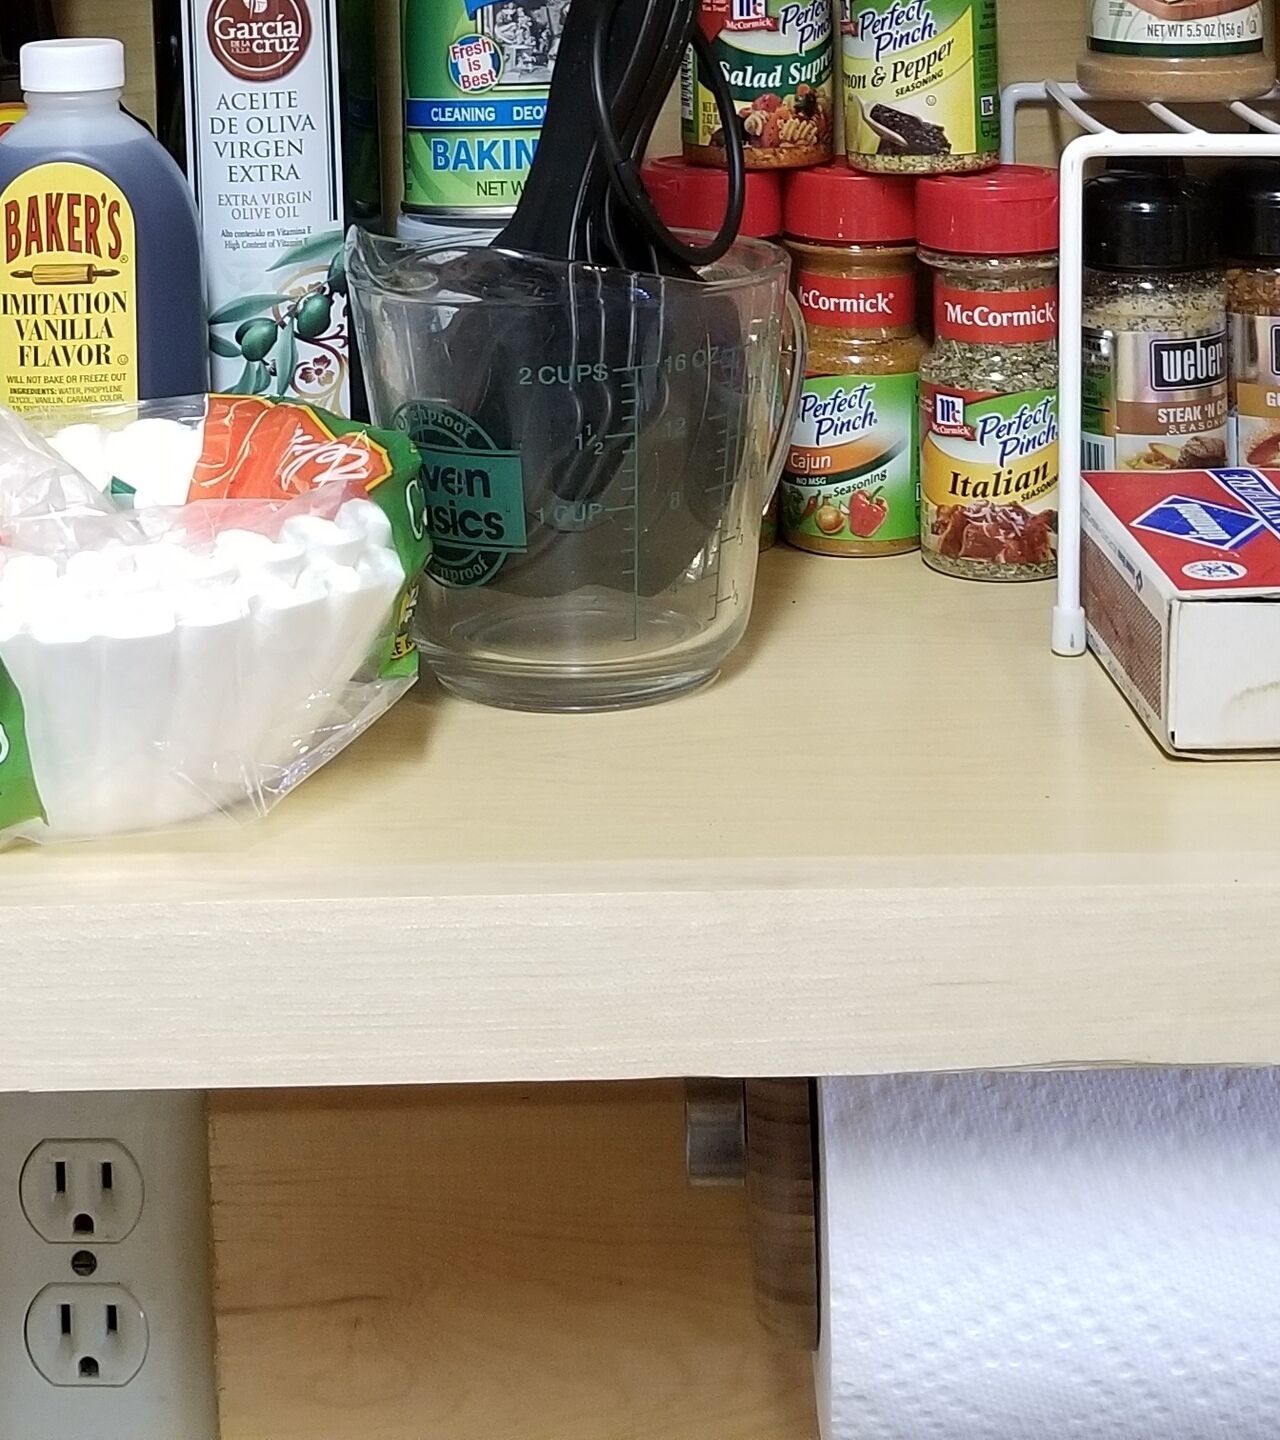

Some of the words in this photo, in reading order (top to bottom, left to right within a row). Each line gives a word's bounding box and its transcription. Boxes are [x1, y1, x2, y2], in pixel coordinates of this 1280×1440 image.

[214, 14, 300, 39] García
[876, 14, 934, 60] Pinch
[1147, 24, 1165, 37] NET
[1168, 25, 1184, 37] WT
[1187, 25, 1201, 37] 5.5
[1204, 24, 1215, 36] OZ
[252, 38, 299, 52] cruz
[451, 39, 492, 60] Fresh
[468, 59, 481, 71] is
[871, 67, 886, 84] &
[892, 38, 954, 84] Pepper
[461, 73, 496, 90] Best
[720, 61, 782, 88] Salad
[895, 69, 943, 97] SEASONING
[216, 91, 297, 110] ACEITE
[210, 117, 238, 134] DE
[246, 114, 316, 134] OLIVA
[431, 107, 496, 122] CLEANING
[213, 139, 303, 158] VIRGEN
[228, 164, 301, 182] EXTRA
[218, 194, 257, 206] EXTRA
[262, 191, 312, 205] VIRGIN
[476, 181, 507, 196] NET
[231, 207, 270, 220] OLIVE
[275, 206, 299, 218] OIL
[5, 193, 122, 264] BAKER'S
[225, 241, 240, 251] High
[242, 240, 267, 249] Content
[2, 291, 127, 315] IMITATION
[945, 301, 1055, 327] McCormick
[15, 318, 114, 341] VANILLA
[19, 343, 110, 367] FLAVOR
[1160, 340, 1224, 382] weber
[7, 376, 24, 384] WILL
[66, 375, 77, 383] OR
[80, 374, 108, 383] FREEZE
[111, 373, 126, 381] OUT
[520, 366, 532, 385] 2
[537, 363, 609, 385] CUPS
[802, 385, 874, 423] Perfect
[816, 408, 874, 445] Pinch
[979, 398, 1054, 446] Perfect
[1158, 408, 1202, 423] STEAK
[999, 415, 1055, 467] Pinch
[791, 450, 831, 472] Cajun
[796, 476, 806, 485] NO
[809, 476, 826, 485] MSG
[833, 469, 888, 498] Seasoning
[949, 461, 1048, 498] Italian
[552, 503, 603, 524] CUP
